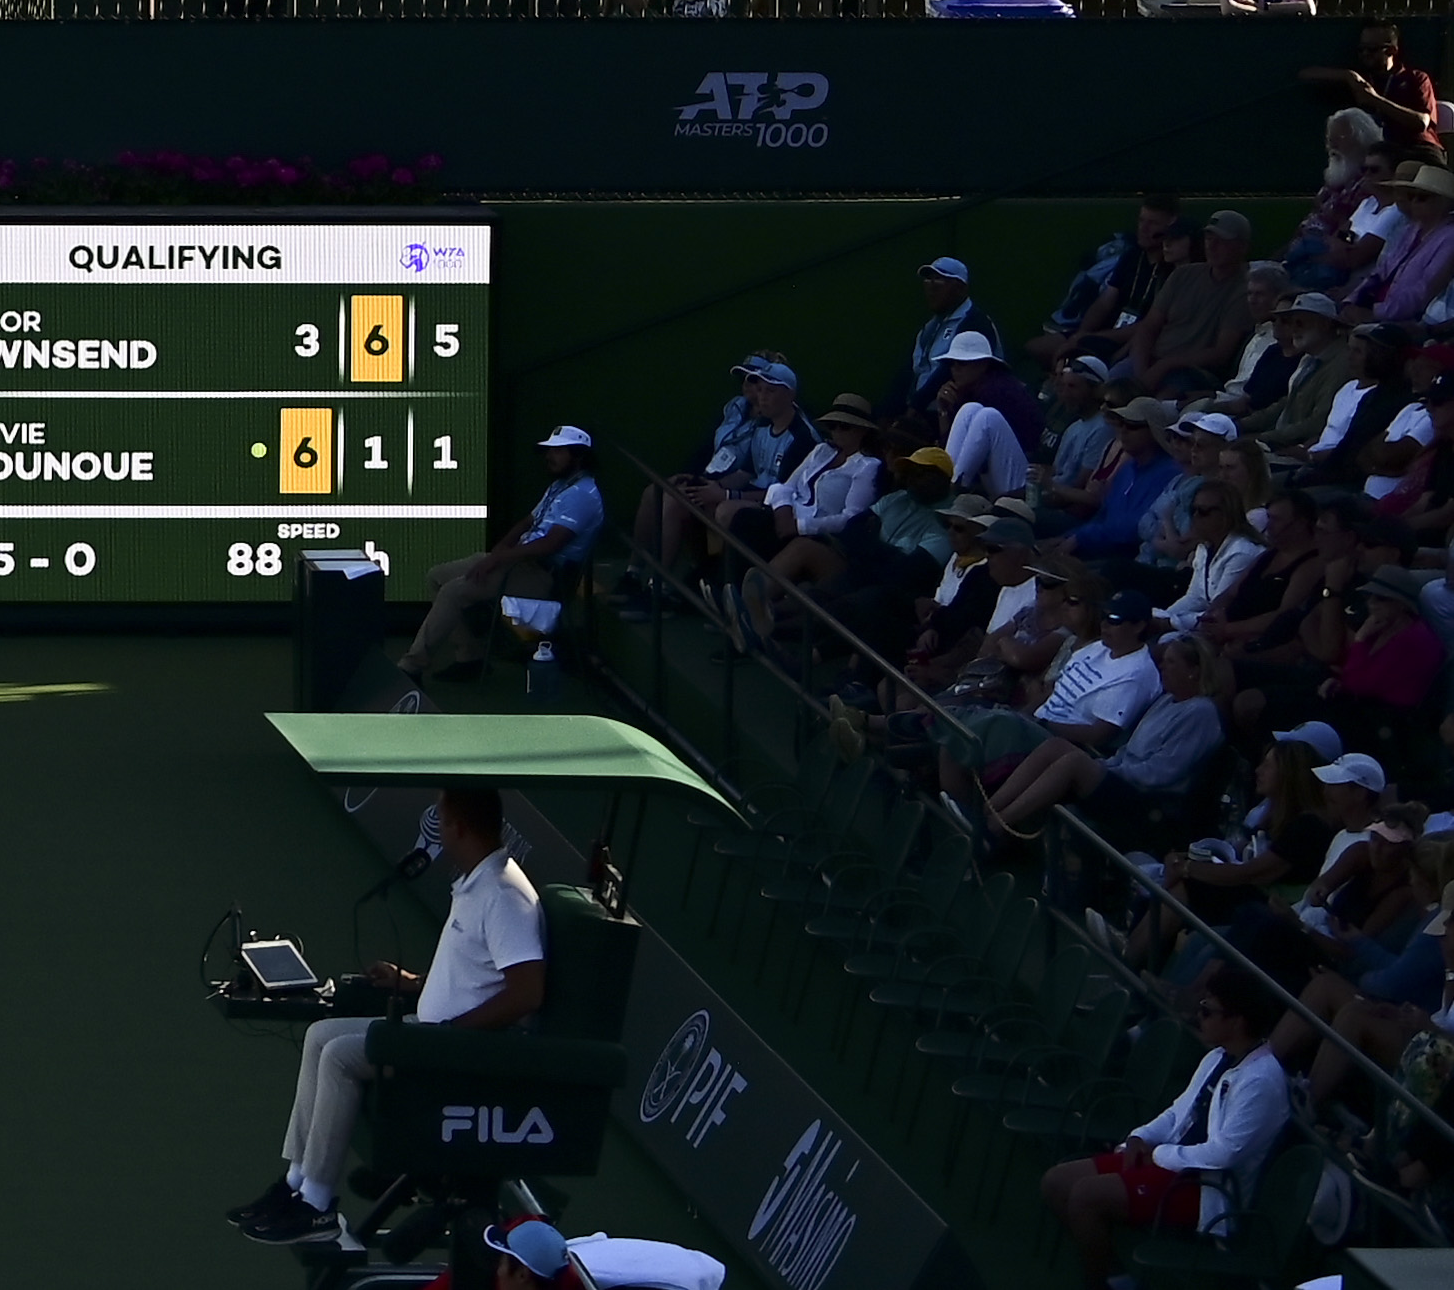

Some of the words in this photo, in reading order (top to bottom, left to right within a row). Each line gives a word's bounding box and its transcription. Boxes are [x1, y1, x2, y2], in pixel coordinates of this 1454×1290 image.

[673, 71, 830, 121] ATP
[673, 122, 754, 138] MASTERS
[755, 122, 830, 149] 1000
[68, 245, 282, 274] QUALIFYING
[433, 247, 465, 257] WTA
[294, 323, 320, 358] 3
[363, 324, 390, 356] 6
[432, 323, 460, 358] 5
[293, 436, 319, 469] 6
[364, 435, 389, 470] 1
[433, 435, 458, 470] 1
[277, 522, 341, 539] SPEED
[64, 542, 96, 577] 0
[226, 542, 283, 576] 88
[670, 1046, 749, 1149] PIF
[440, 1104, 555, 1145] FILA
